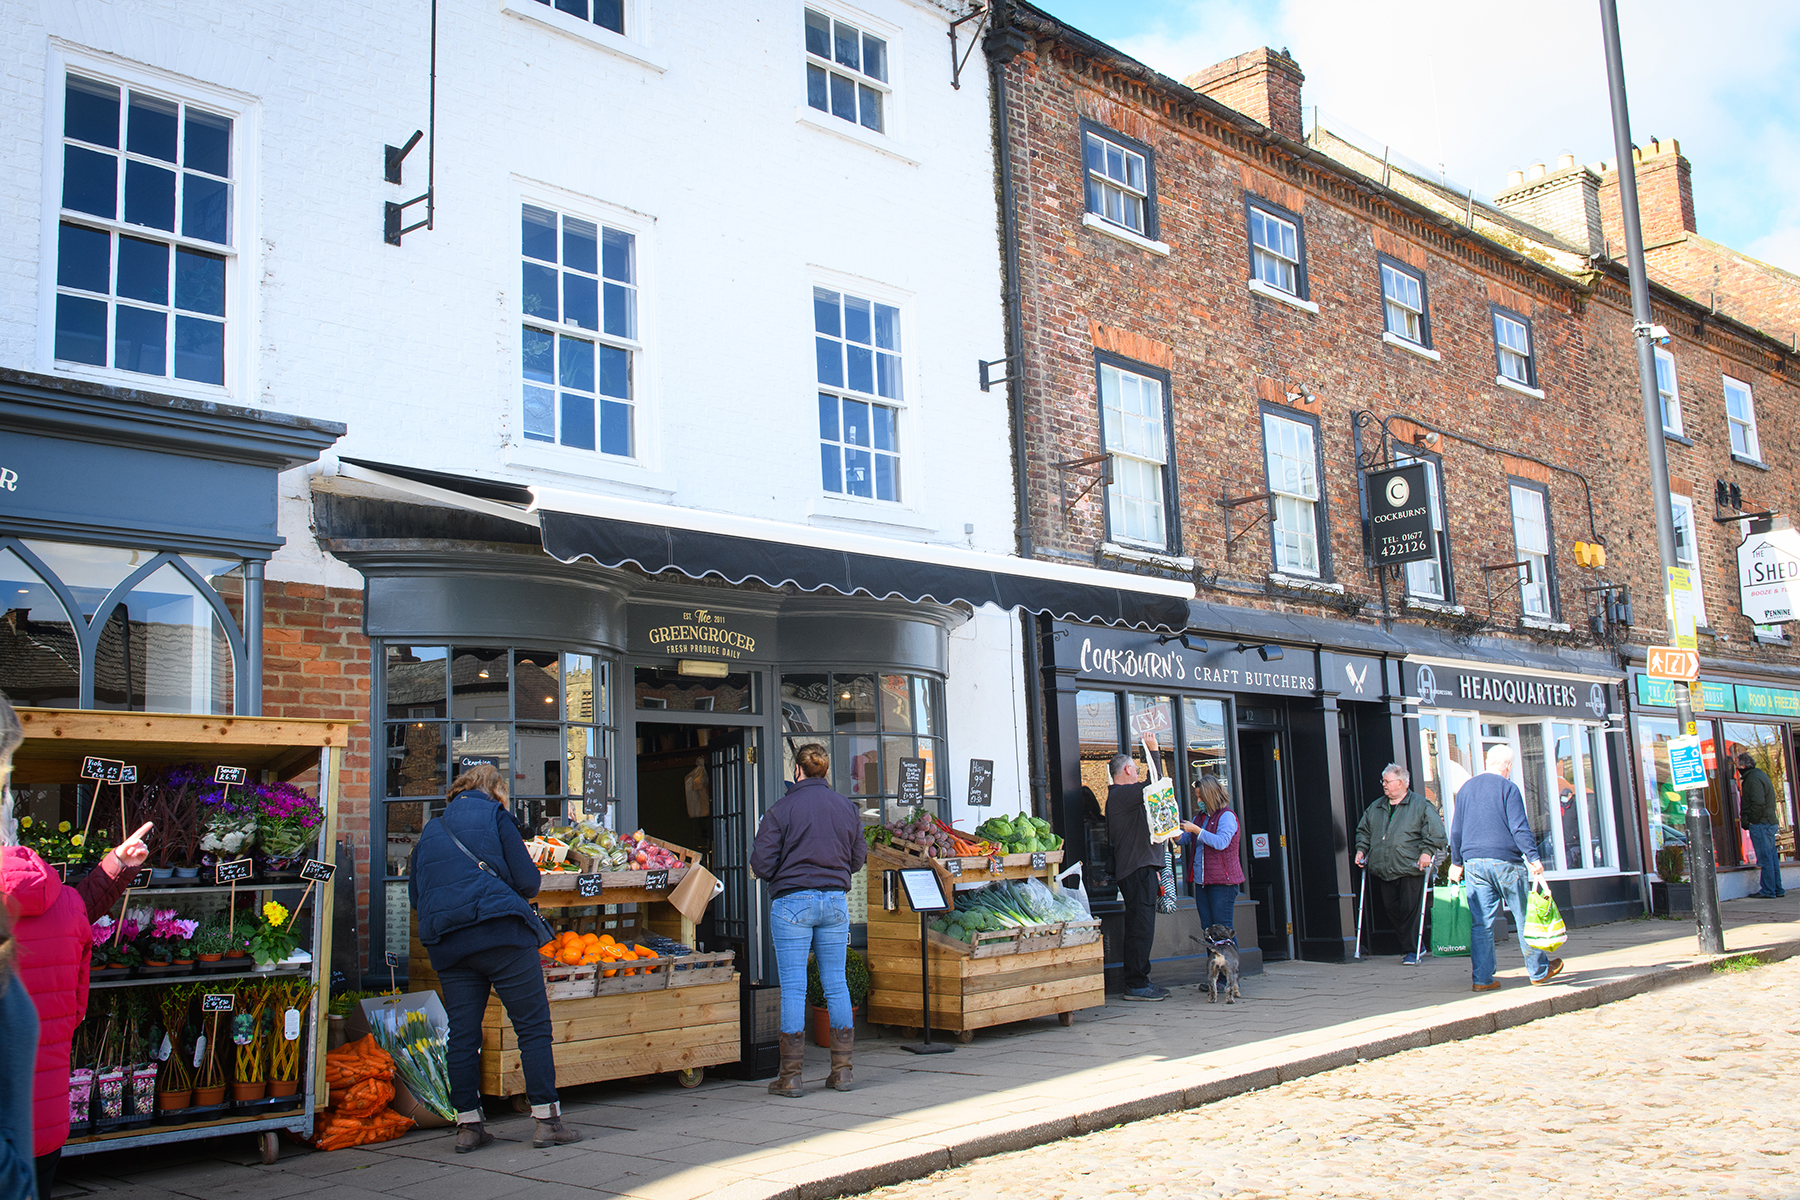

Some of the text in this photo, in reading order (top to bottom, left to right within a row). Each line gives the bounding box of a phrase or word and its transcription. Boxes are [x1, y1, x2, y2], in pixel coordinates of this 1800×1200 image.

[0, 466, 18, 492] R
[1374, 506, 1427, 524] COCKBURN'S
[1382, 531, 1422, 544] TEL: 01677
[1381, 540, 1427, 556] 422126
[1752, 550, 1764, 558] THE
[1754, 562, 1798, 582] SHED
[683, 612, 692, 620] EST.
[694, 610, 712, 624] The
[1764, 608, 1790, 618] PENNINE
[649, 626, 755, 652] GREENGROCER
[666, 645, 740, 659] FRESH PRODUCE DAILY
[1080, 638, 1315, 690] COCKBURN'S CRAFT BUTCHERS
[1460, 675, 1577, 707] HEADQUARTERS
[1649, 686, 1660, 698] THE
[1749, 694, 1766, 708] FOOD
[1768, 695, 1773, 708] &
[1246, 710, 1254, 721] 12
[1688, 723, 1695, 732] 9
[1437, 944, 1466, 952] Waitrose
